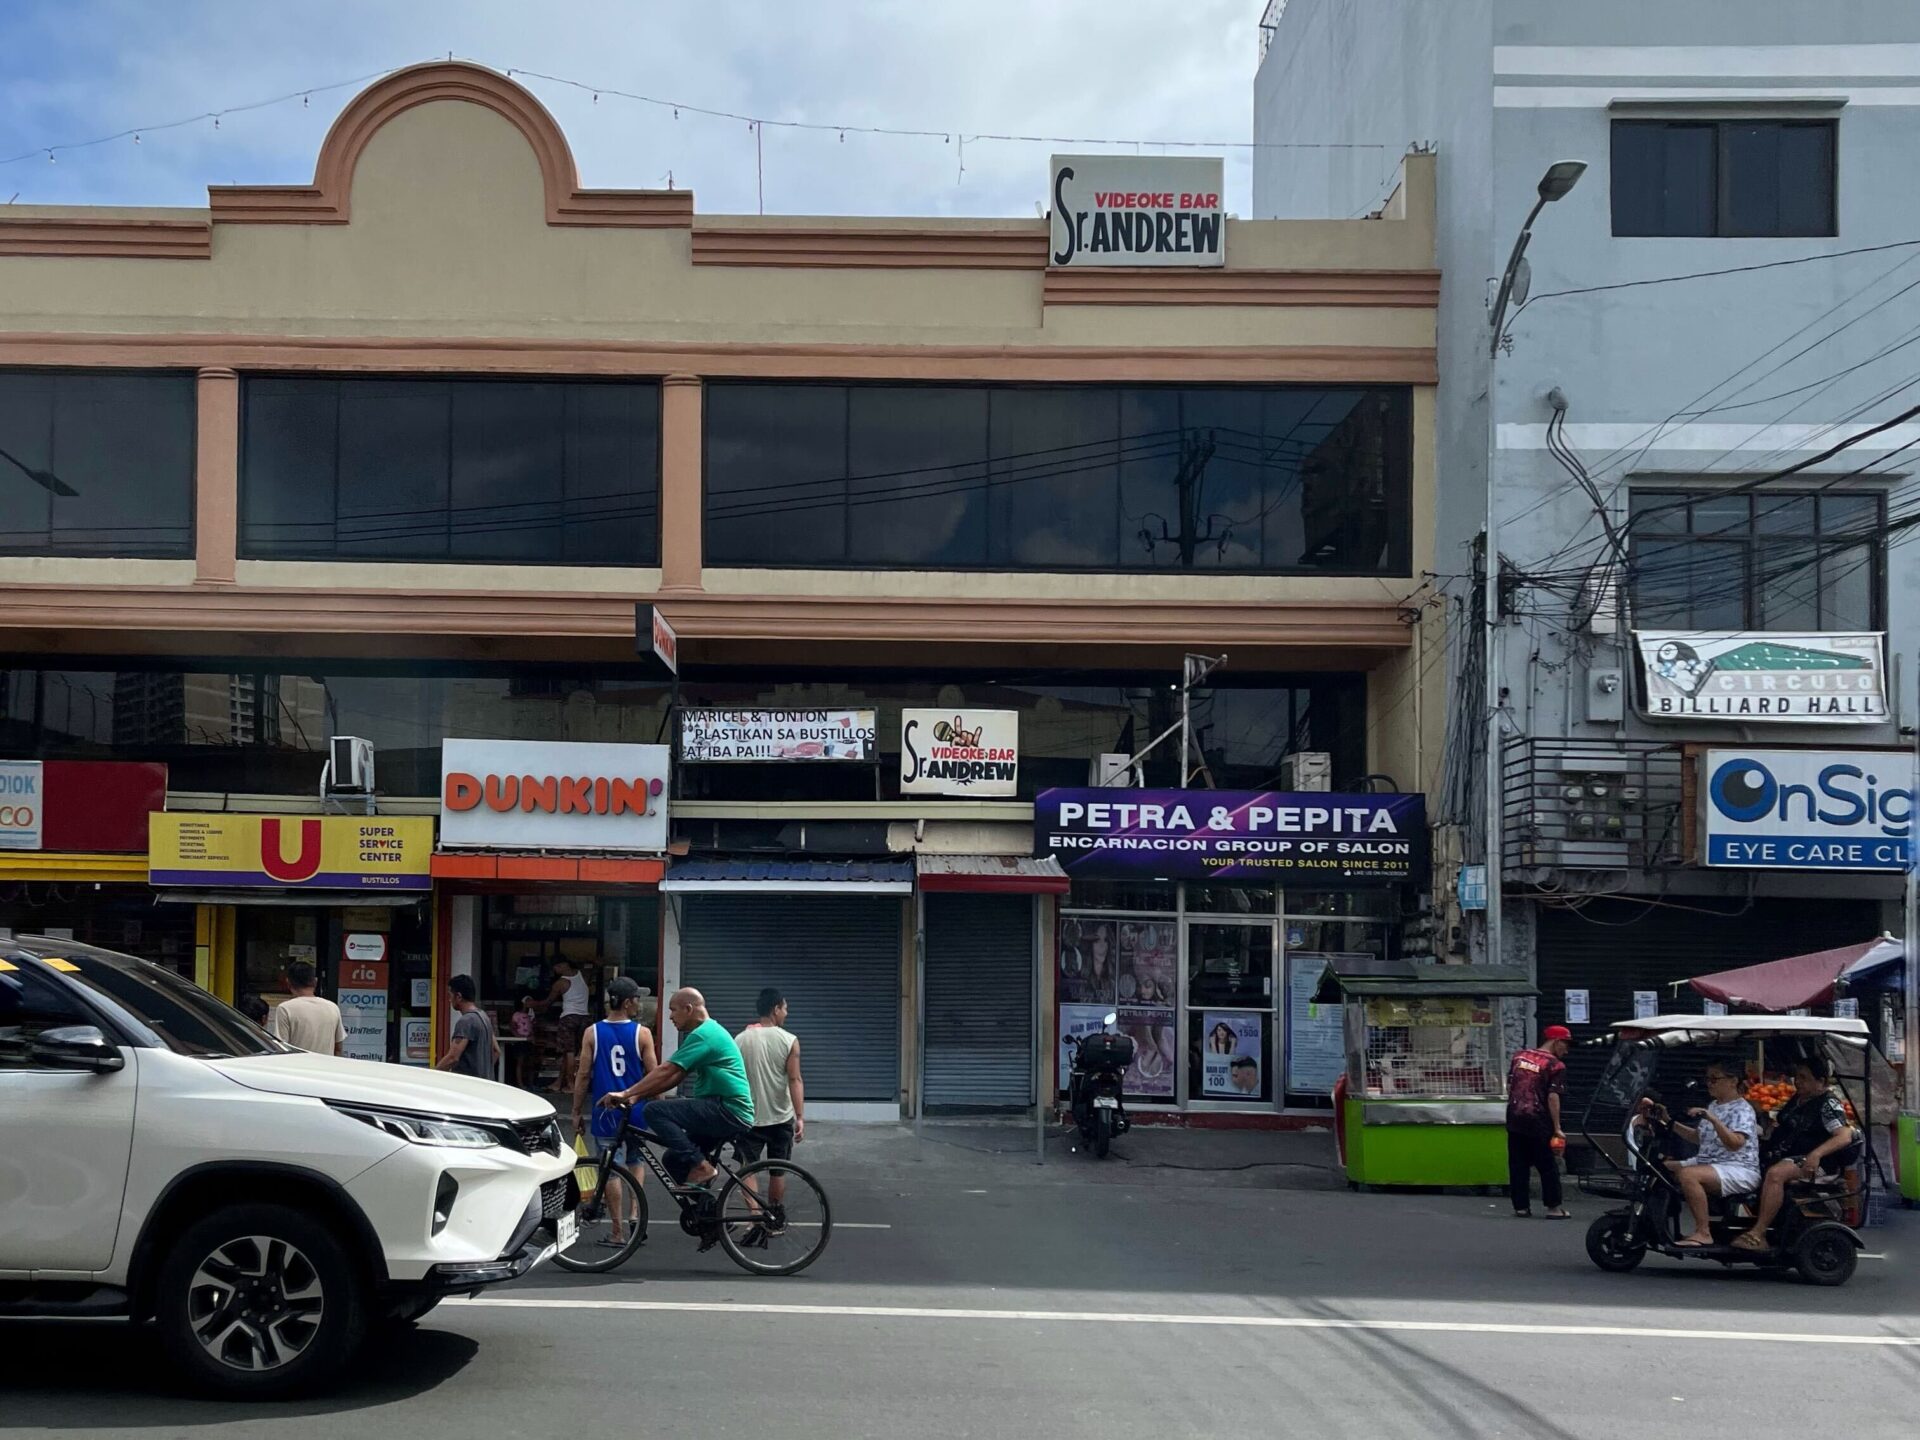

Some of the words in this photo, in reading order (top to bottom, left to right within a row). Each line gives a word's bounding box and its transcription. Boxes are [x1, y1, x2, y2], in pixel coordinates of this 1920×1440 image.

[1094, 192, 1174, 208] VIDEOKE
[1180, 193, 1218, 209] BAR
[1719, 674, 1873, 690] CIRCULO
[1661, 697, 1790, 713] BILLIARD
[1808, 697, 1874, 712] HALL
[682, 710, 744, 722] MARICEL
[750, 711, 762, 722] &
[768, 711, 828, 723] TONTON
[695, 729, 773, 740] PLASTIKAN
[778, 729, 796, 739] SA
[801, 728, 875, 740] BUSTILLOS
[686, 746, 701, 757] AT
[708, 746, 732, 757] IBA
[737, 745, 771, 757] PA!!!
[932, 747, 985, 759] VIDEOKE
[989, 749, 1015, 760] BAR
[445, 772, 664, 816] DUNKIN'
[1060, 802, 1196, 830] PETRA
[1208, 806, 1236, 831] &
[1249, 807, 1398, 833] PEPITA
[359, 827, 394, 837] SUPER
[261, 818, 322, 881] U
[1049, 836, 1207, 851] ENCARNACION
[1216, 840, 1293, 852] GROUP
[1300, 842, 1330, 853] OF
[1337, 843, 1410, 854] SALON
[1726, 842, 1776, 860] EYE
[1788, 844, 1863, 861] CARE
[359, 852, 402, 862] CENTER
[1202, 858, 1235, 867] YOUR
[1239, 858, 1294, 868] TRUSTED
[1298, 859, 1338, 869] SALON
[1342, 860, 1379, 869] SINCE
[1383, 861, 1410, 870] 2011
[361, 877, 400, 885] BUSTILLOS
[352, 964, 377, 980] ria
[341, 994, 386, 1005] xoom
[1238, 1029, 1259, 1037] 1500
[610, 1044, 626, 1077] 6
[1208, 1077, 1225, 1086] 100
[639, 1146, 666, 1177] SANTA
